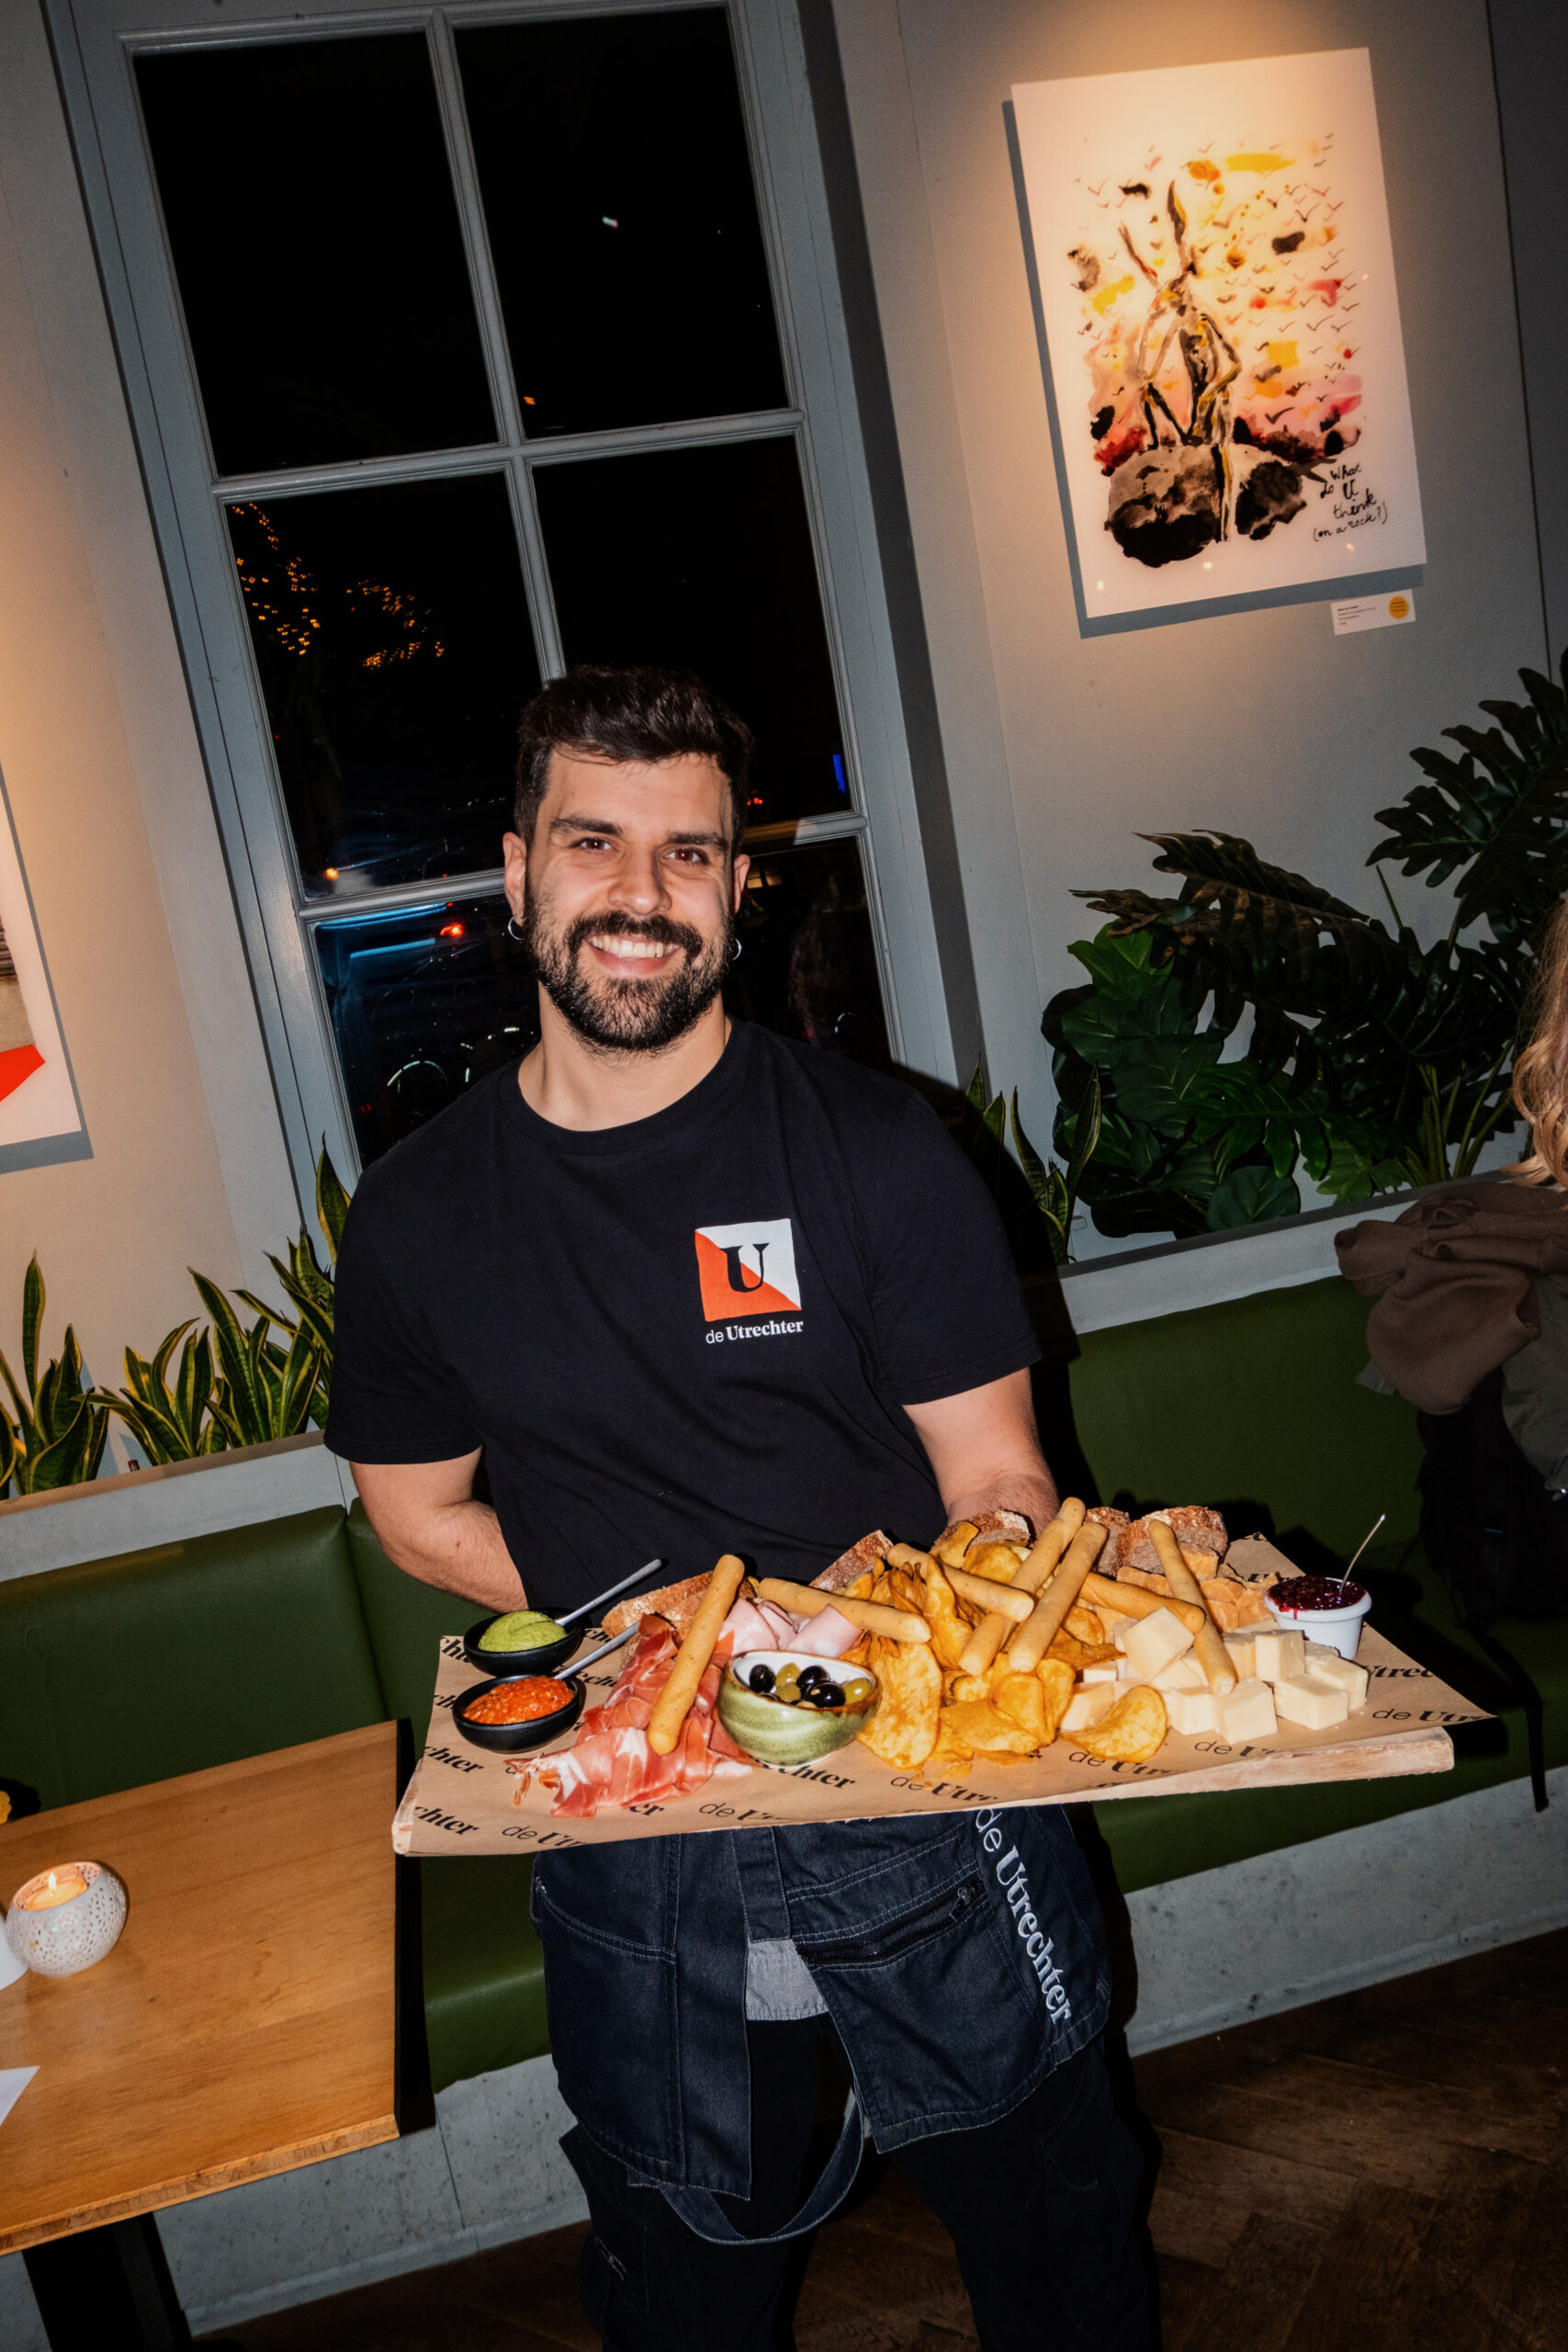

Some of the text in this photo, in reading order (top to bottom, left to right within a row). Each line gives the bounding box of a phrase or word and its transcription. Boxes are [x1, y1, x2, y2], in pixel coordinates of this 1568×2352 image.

[1333, 488, 1377, 520] think
[720, 1242, 770, 1293] U
[705, 1320, 804, 1344] de Utrechter
[1372, 1709, 1411, 1720] de
[1194, 1741, 1233, 1755] de
[699, 1803, 735, 1817] de
[502, 1826, 537, 1839] de
[976, 1808, 1071, 2025] de Utrechter
